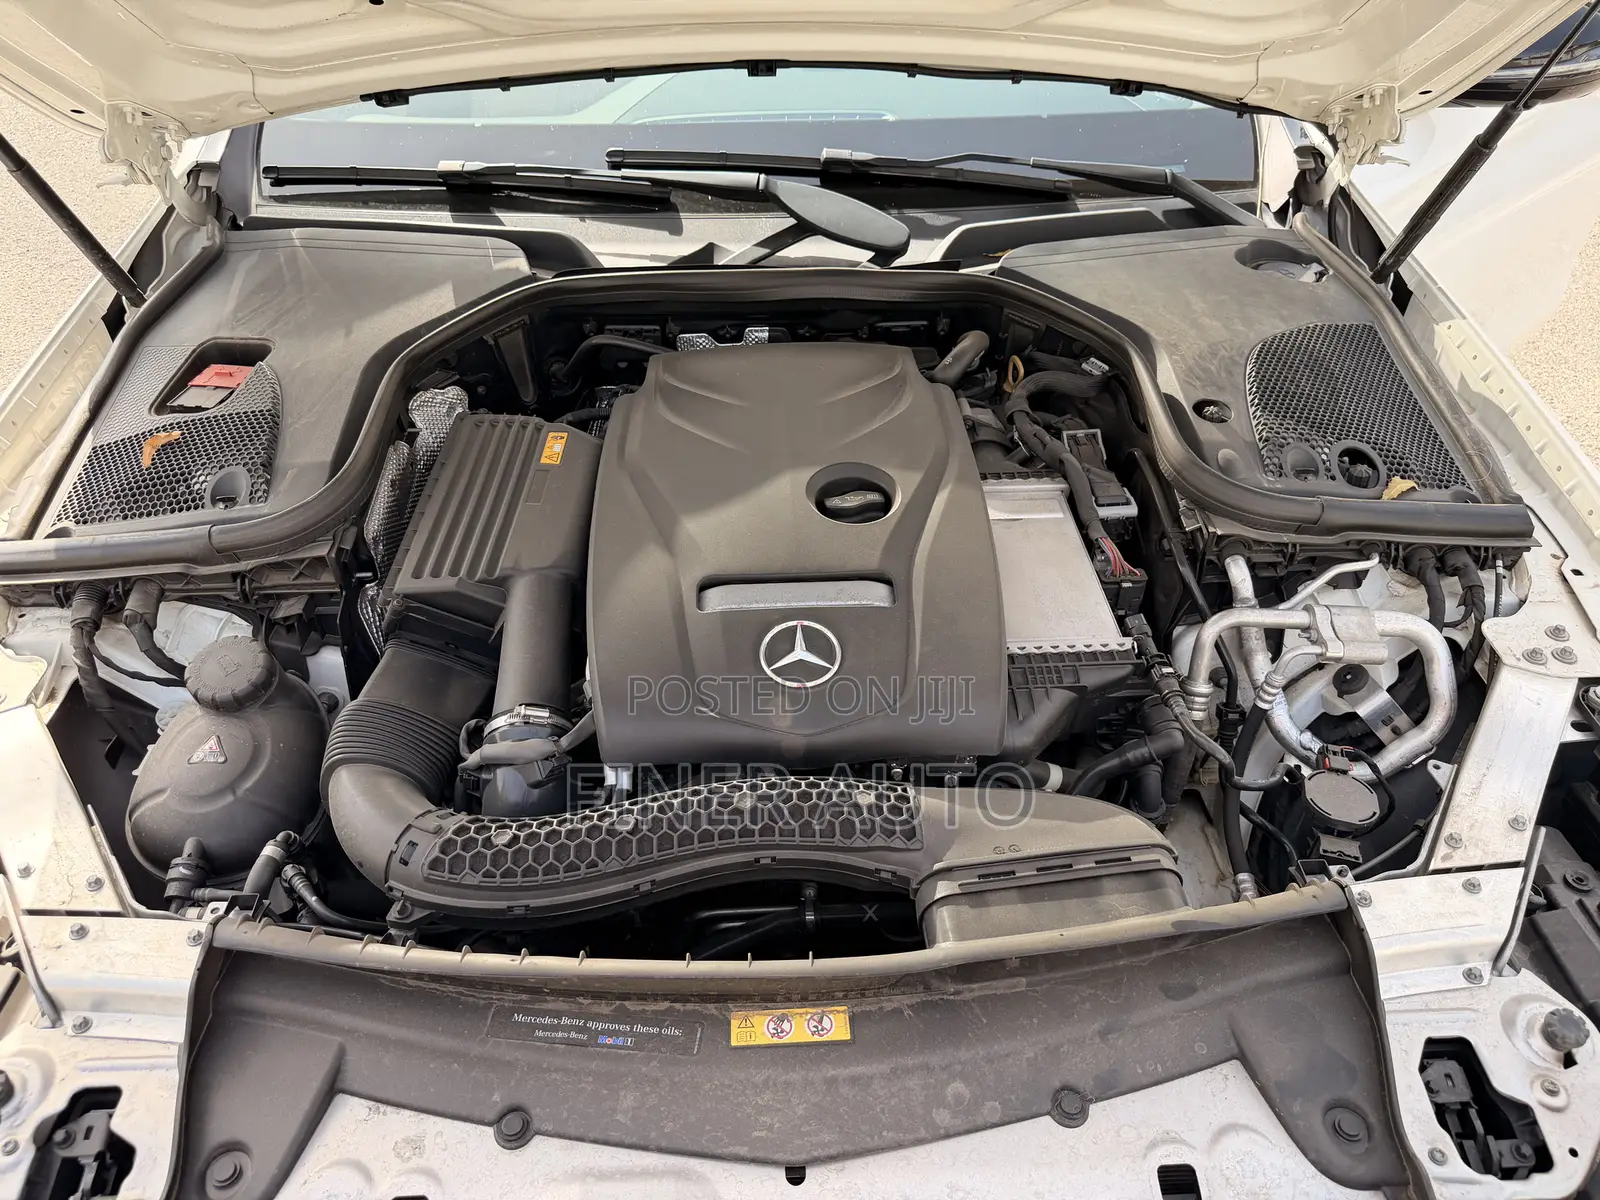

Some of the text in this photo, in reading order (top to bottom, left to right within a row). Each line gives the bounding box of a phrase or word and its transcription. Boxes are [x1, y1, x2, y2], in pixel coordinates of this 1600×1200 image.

[511, 1012, 683, 1036] Mercedes-Benz approves these oils:
[533, 1029, 589, 1041] Mercedes-Benz
[598, 1035, 624, 1046] Mobil
